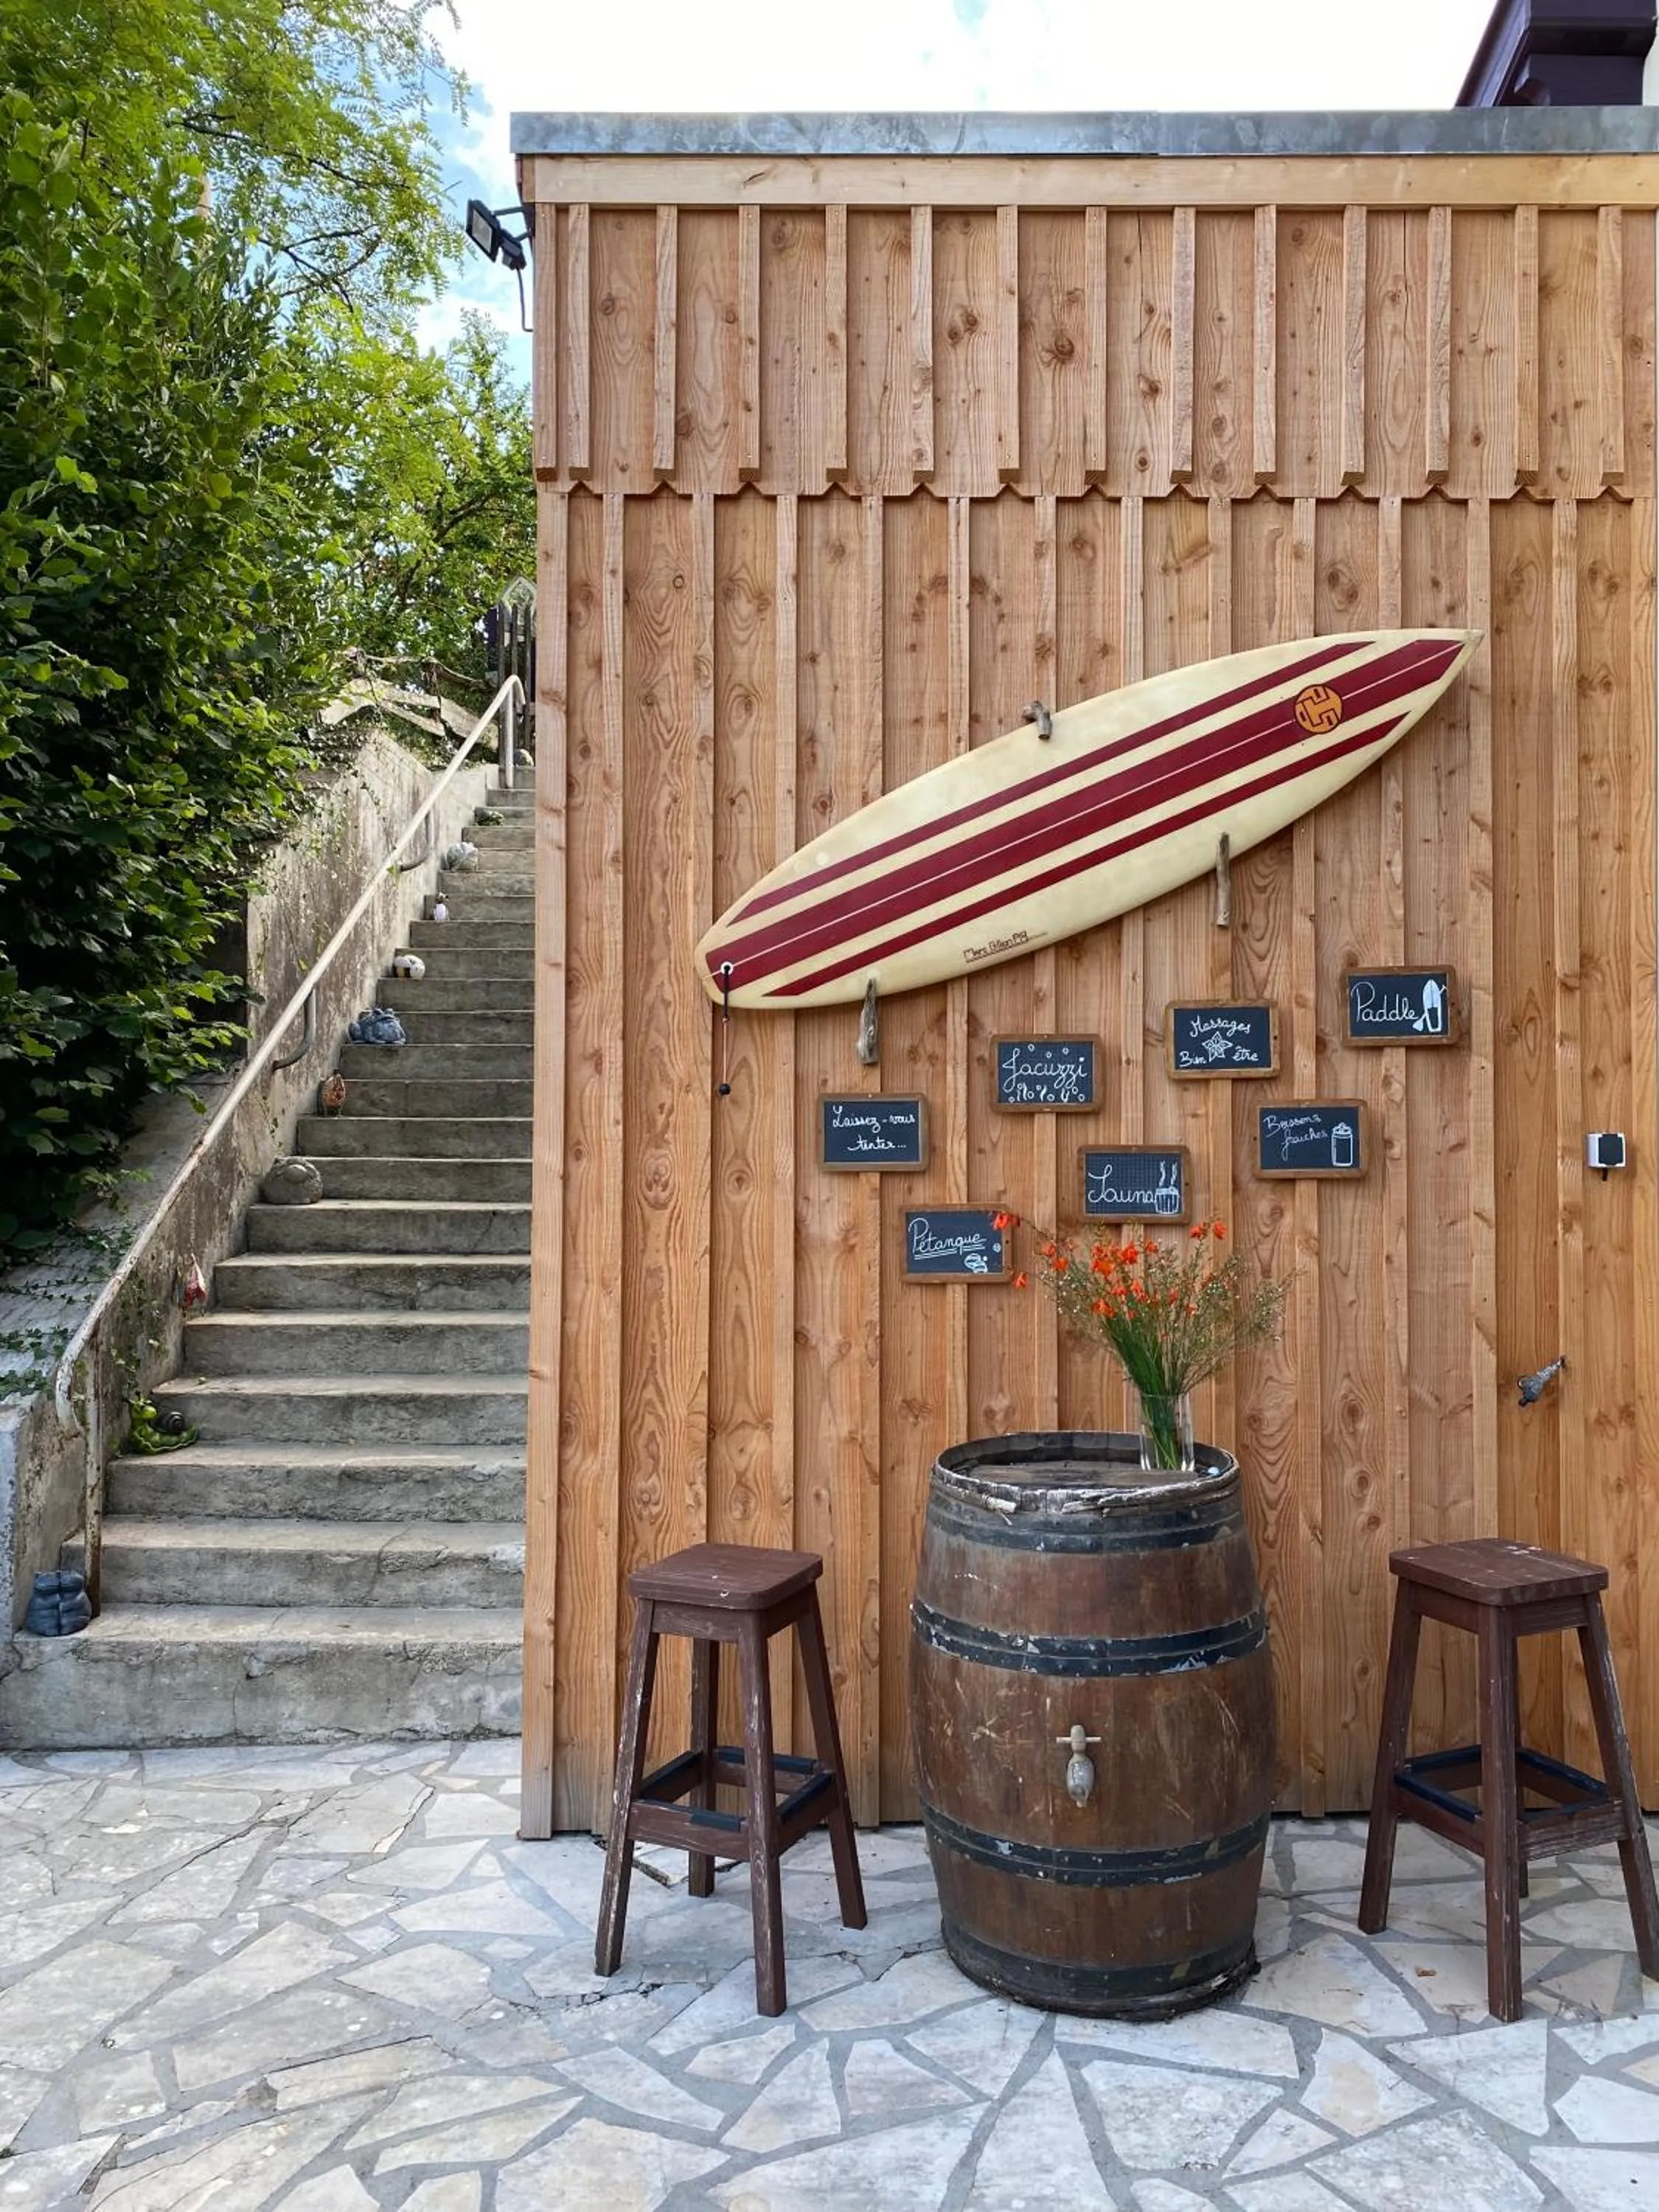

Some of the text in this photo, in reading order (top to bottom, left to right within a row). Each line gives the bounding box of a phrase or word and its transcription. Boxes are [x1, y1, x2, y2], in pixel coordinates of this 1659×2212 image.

[1351, 981, 1419, 1022] Paddle
[1002, 1048, 1088, 1093] Jacuzzi
[1088, 1164, 1156, 1203] Sauna
[908, 1217, 987, 1255] Pétanque
